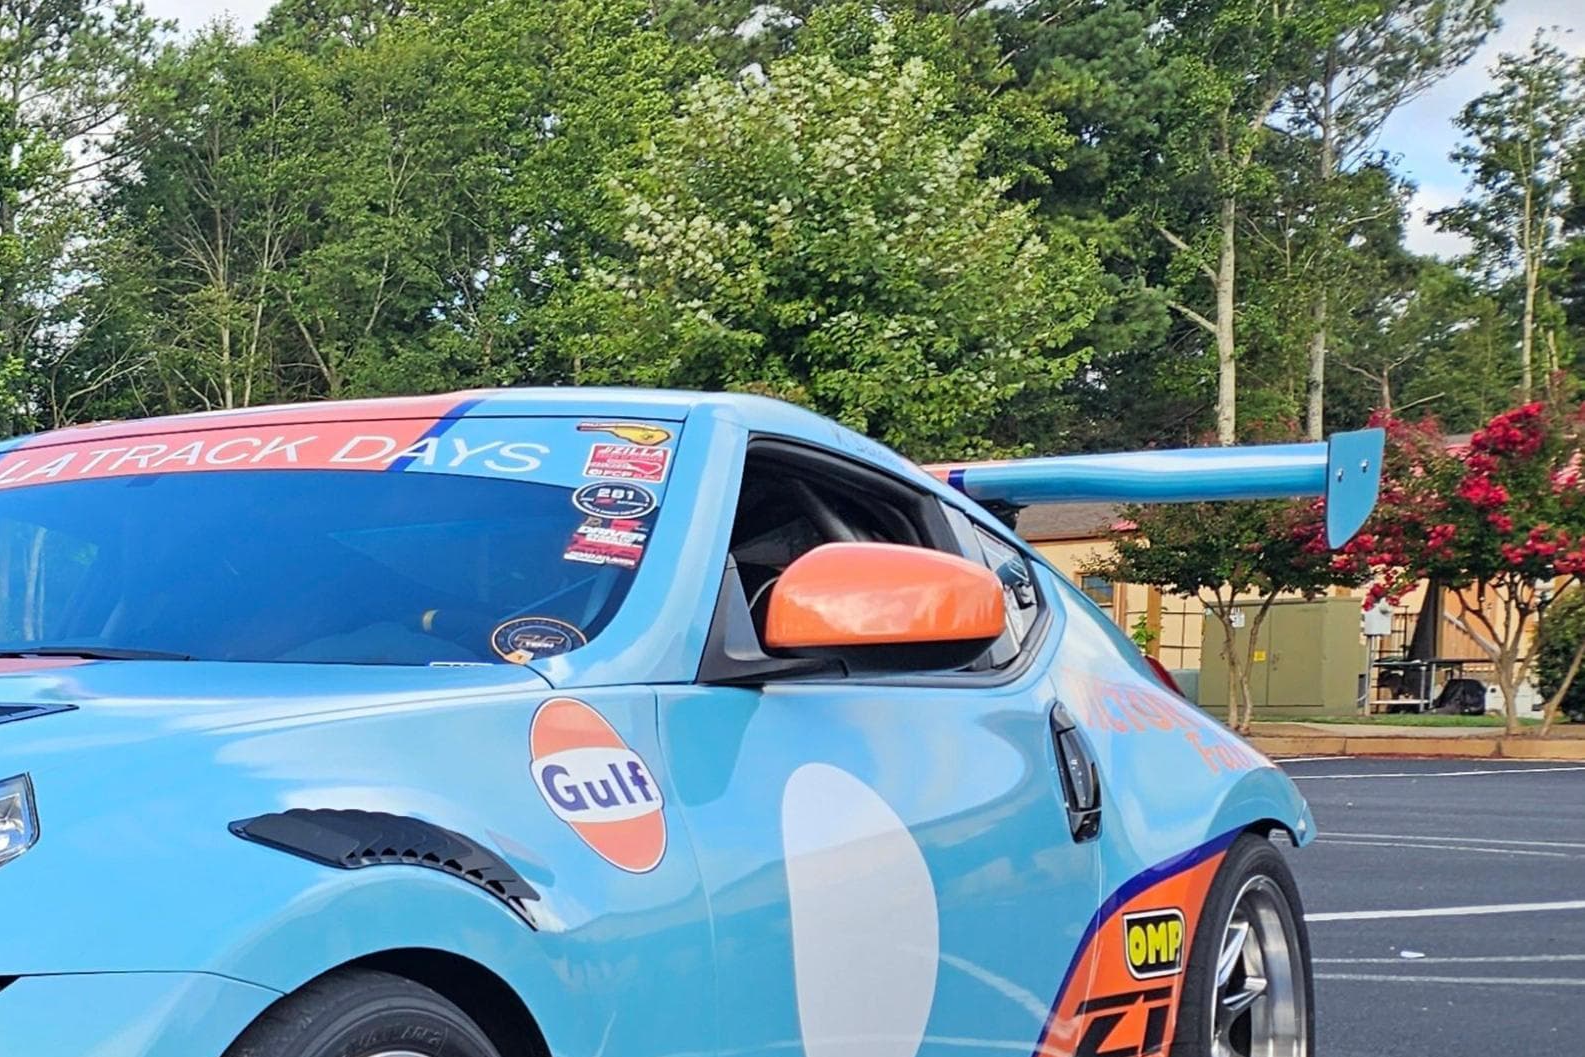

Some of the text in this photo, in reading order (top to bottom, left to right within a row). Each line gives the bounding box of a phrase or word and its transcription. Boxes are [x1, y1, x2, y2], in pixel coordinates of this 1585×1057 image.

[79, 435, 319, 475] TRACK
[330, 435, 551, 473] DAYS
[540, 760, 654, 813] Gulf
[1127, 920, 1183, 967] OMP
